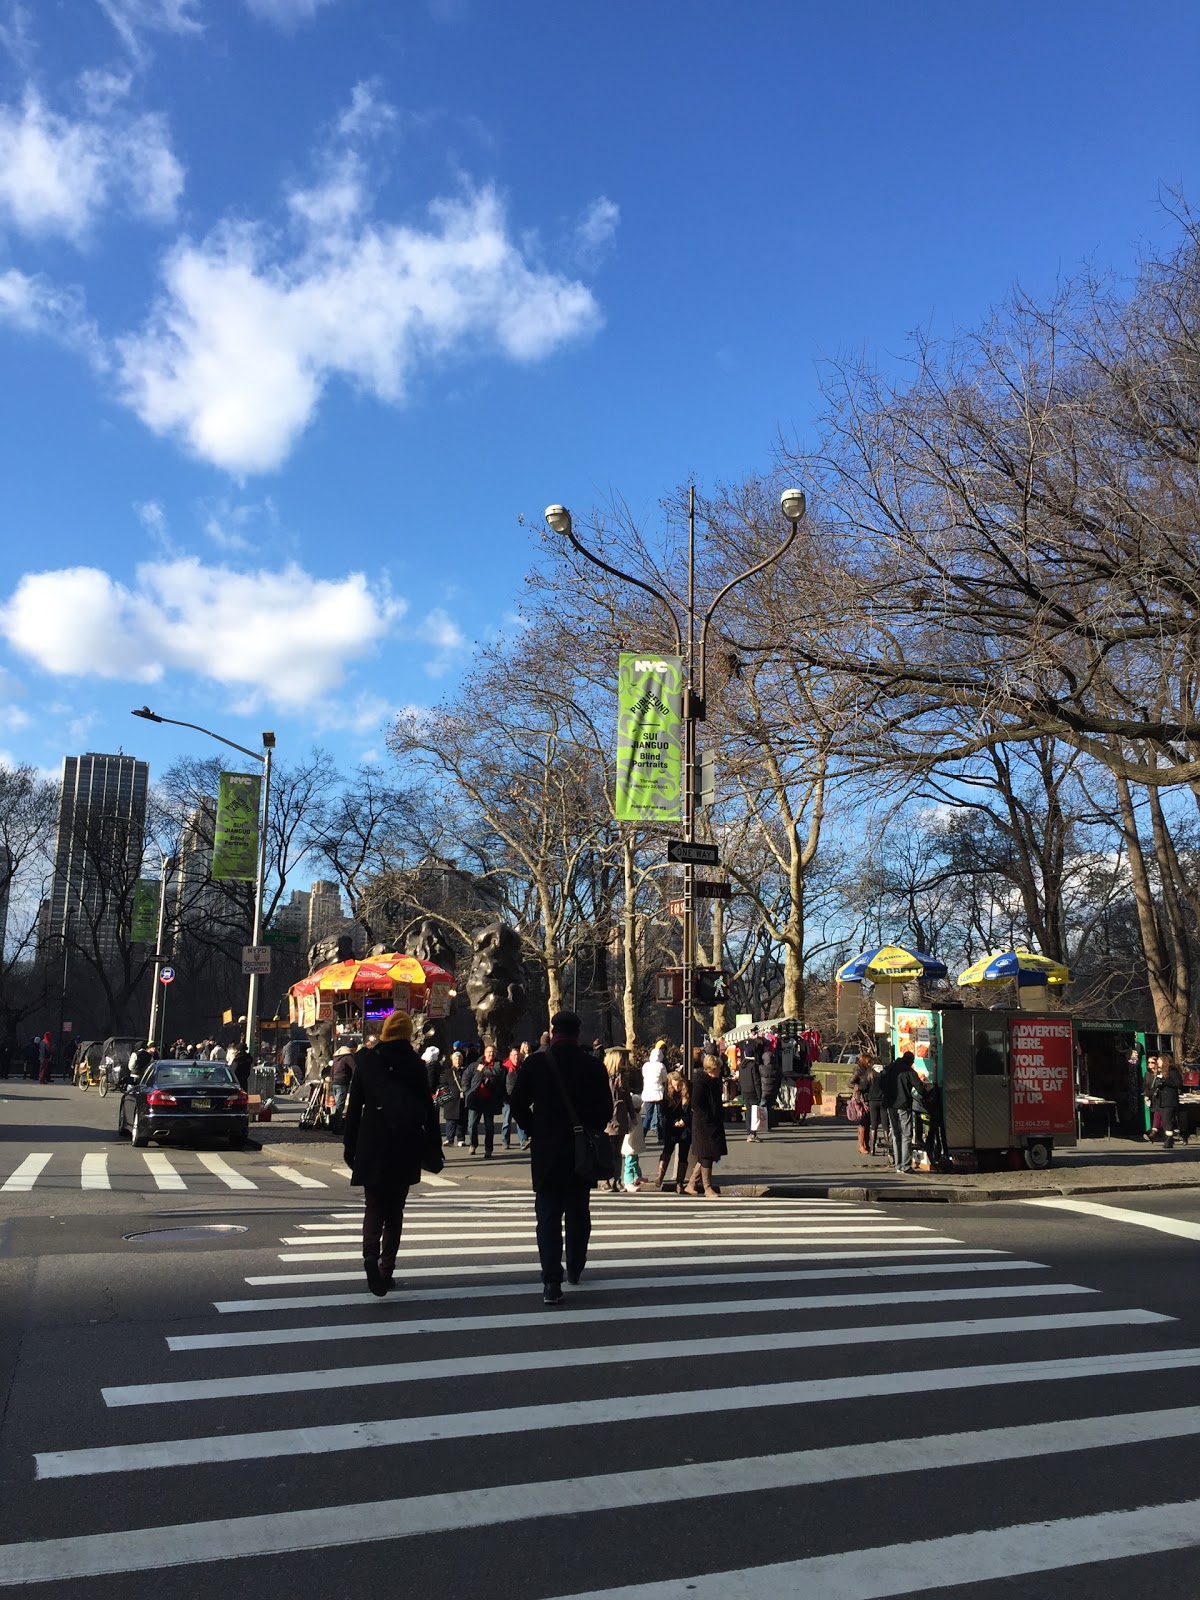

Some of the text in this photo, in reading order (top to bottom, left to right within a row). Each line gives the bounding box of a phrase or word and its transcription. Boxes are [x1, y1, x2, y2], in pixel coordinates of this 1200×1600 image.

[634, 660, 668, 672] NYC
[630, 691, 654, 714] PUBLIC
[640, 699, 654, 716] ART
[652, 695, 670, 716] FUND
[642, 732, 658, 740] SUI
[631, 741, 669, 750] JIANGUO
[640, 752, 661, 760] Blind
[632, 760, 668, 768] Portraits
[230, 776, 252, 786] NYC
[225, 796, 243, 811] PUBLIC
[677, 848, 712, 859] ONE WAY
[704, 886, 722, 896] 5 Av
[670, 904, 674, 914] E
[871, 967, 919, 975] SABRETT
[1012, 1026, 1070, 1037] ADVERTISE
[1012, 1038, 1044, 1050] HERE.
[1013, 1054, 1045, 1066] YOUR
[1013, 1067, 1068, 1079] AUDIENCE
[1013, 1080, 1063, 1091] WILL EAT
[1014, 1092, 1044, 1104] IT UP.
